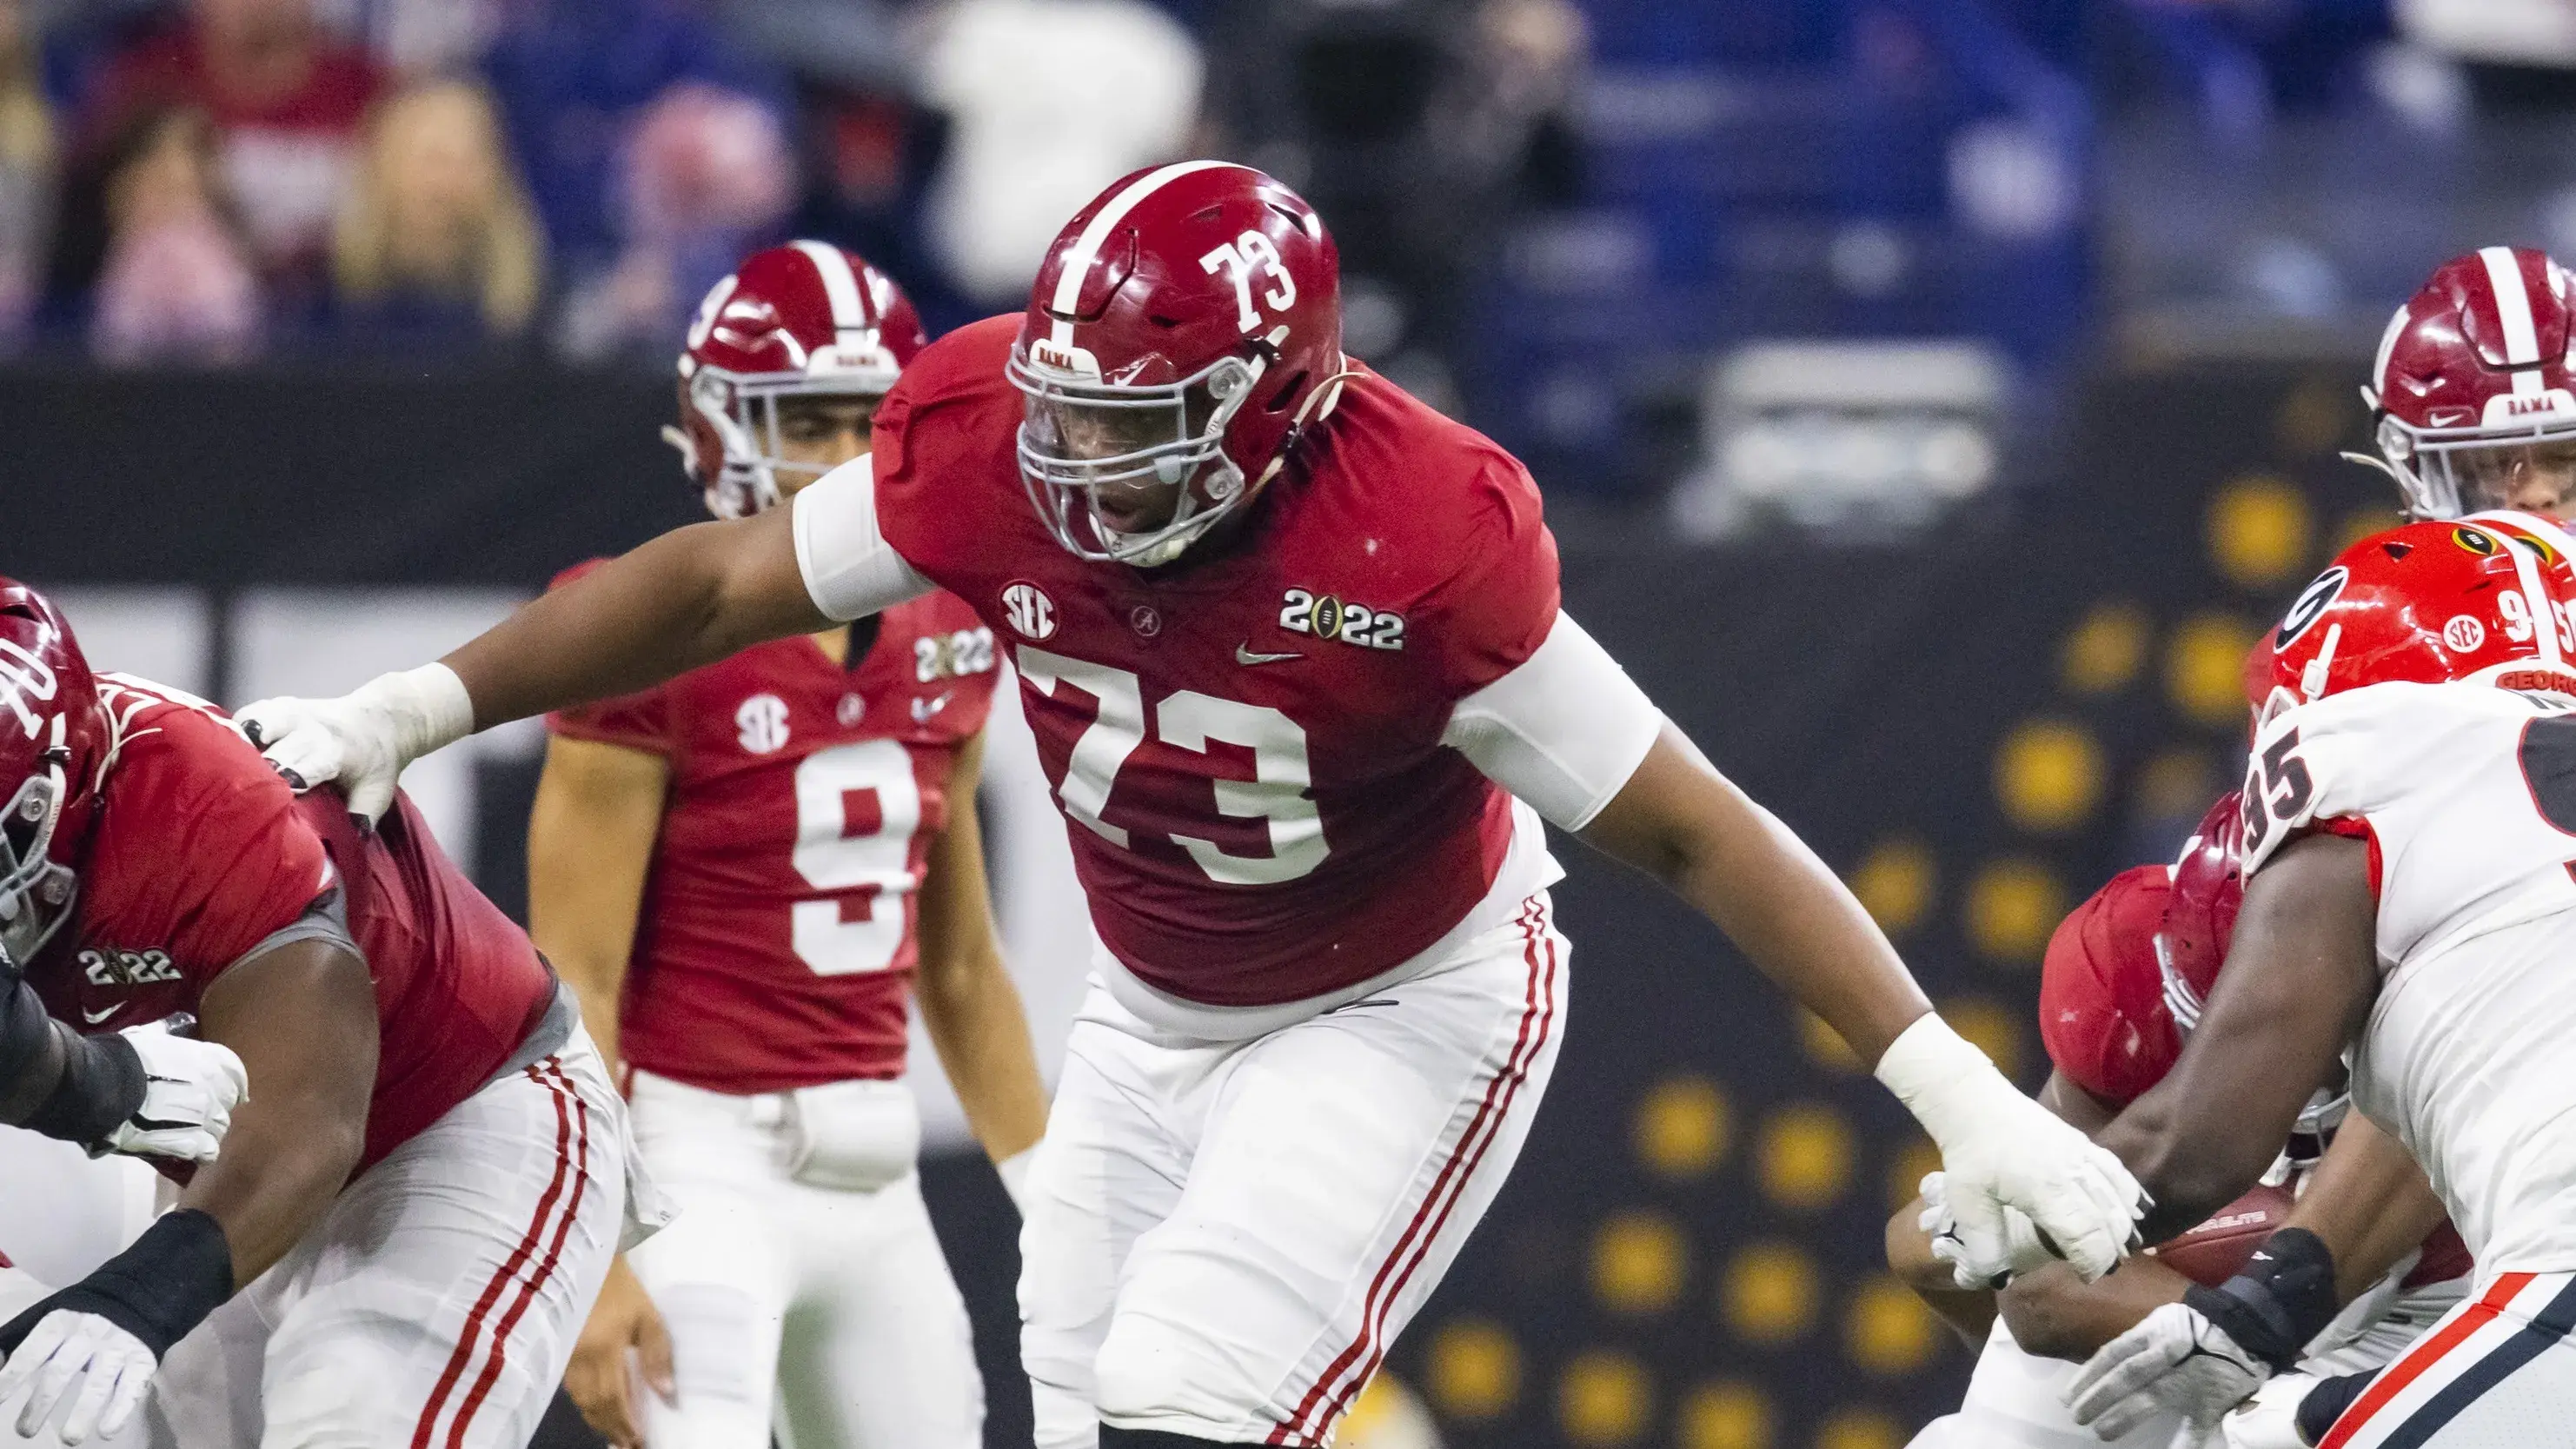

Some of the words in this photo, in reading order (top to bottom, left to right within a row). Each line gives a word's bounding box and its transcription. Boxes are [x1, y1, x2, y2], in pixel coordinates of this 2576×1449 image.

[1198, 229, 1296, 334] 73
[1039, 346, 1074, 371] BAMA
[2507, 396, 2555, 415] BAMA
[1001, 584, 1055, 639] SEC
[1279, 588, 1404, 650] 2022
[2447, 618, 2480, 649] SEC
[1015, 643, 1331, 885] 73
[2241, 725, 2314, 855] 95
[792, 738, 920, 975] 9
